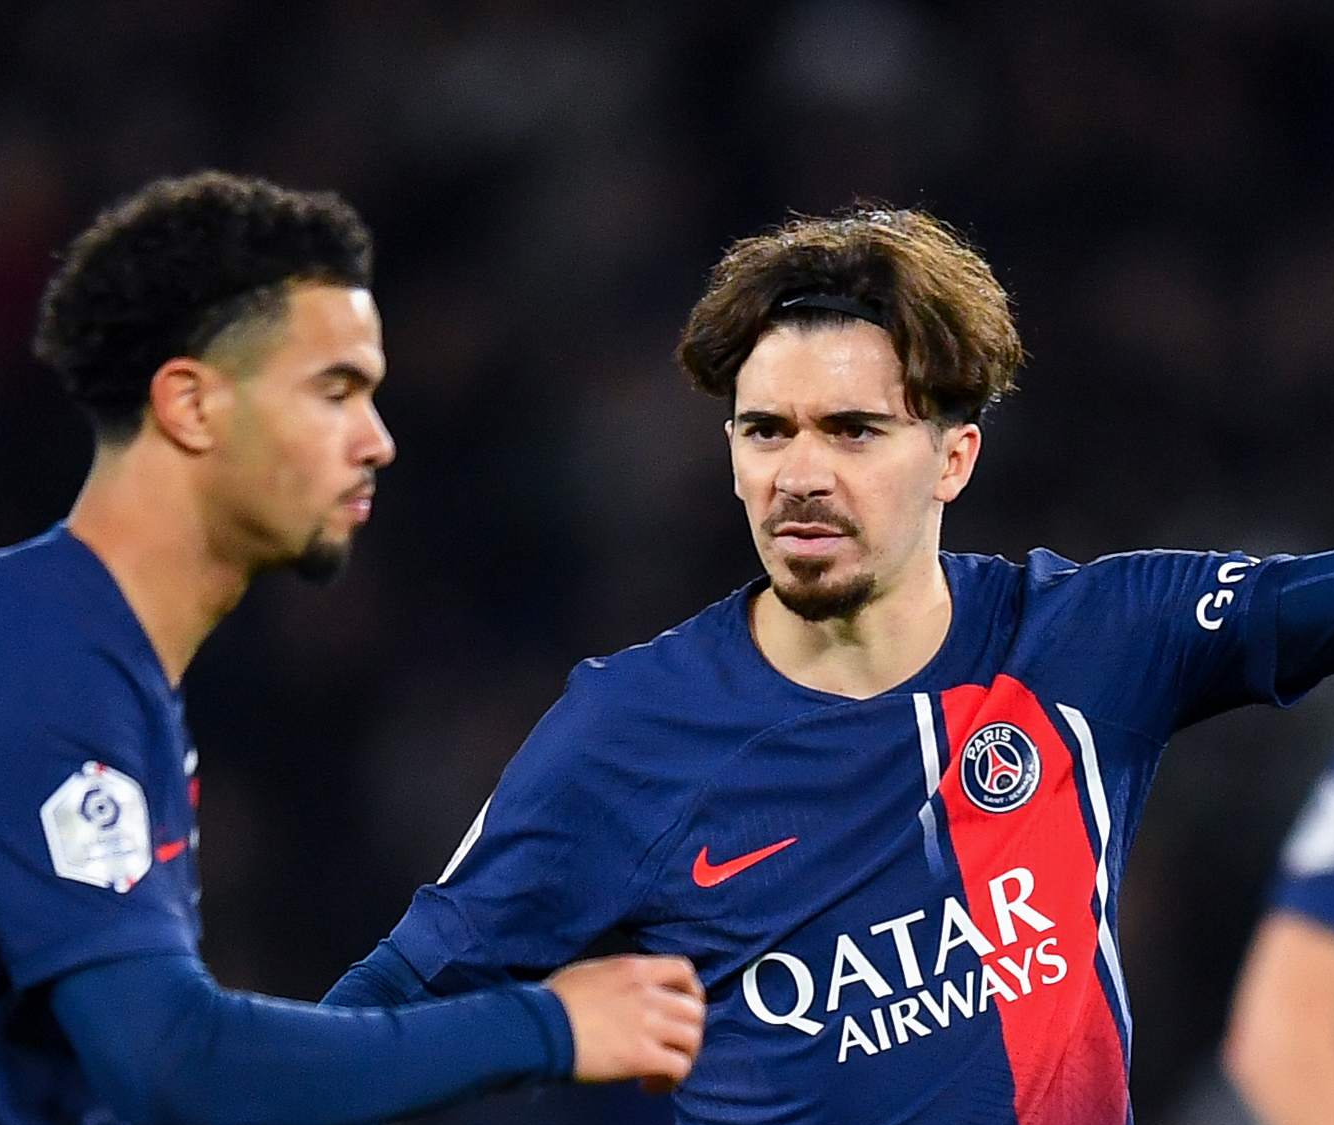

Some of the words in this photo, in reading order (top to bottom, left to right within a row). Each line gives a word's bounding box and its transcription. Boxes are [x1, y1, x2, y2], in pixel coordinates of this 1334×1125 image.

[966, 728, 1012, 761] PARIS
[742, 867, 1056, 1036] QATAR
[837, 937, 1068, 1063] AIRWAYS
